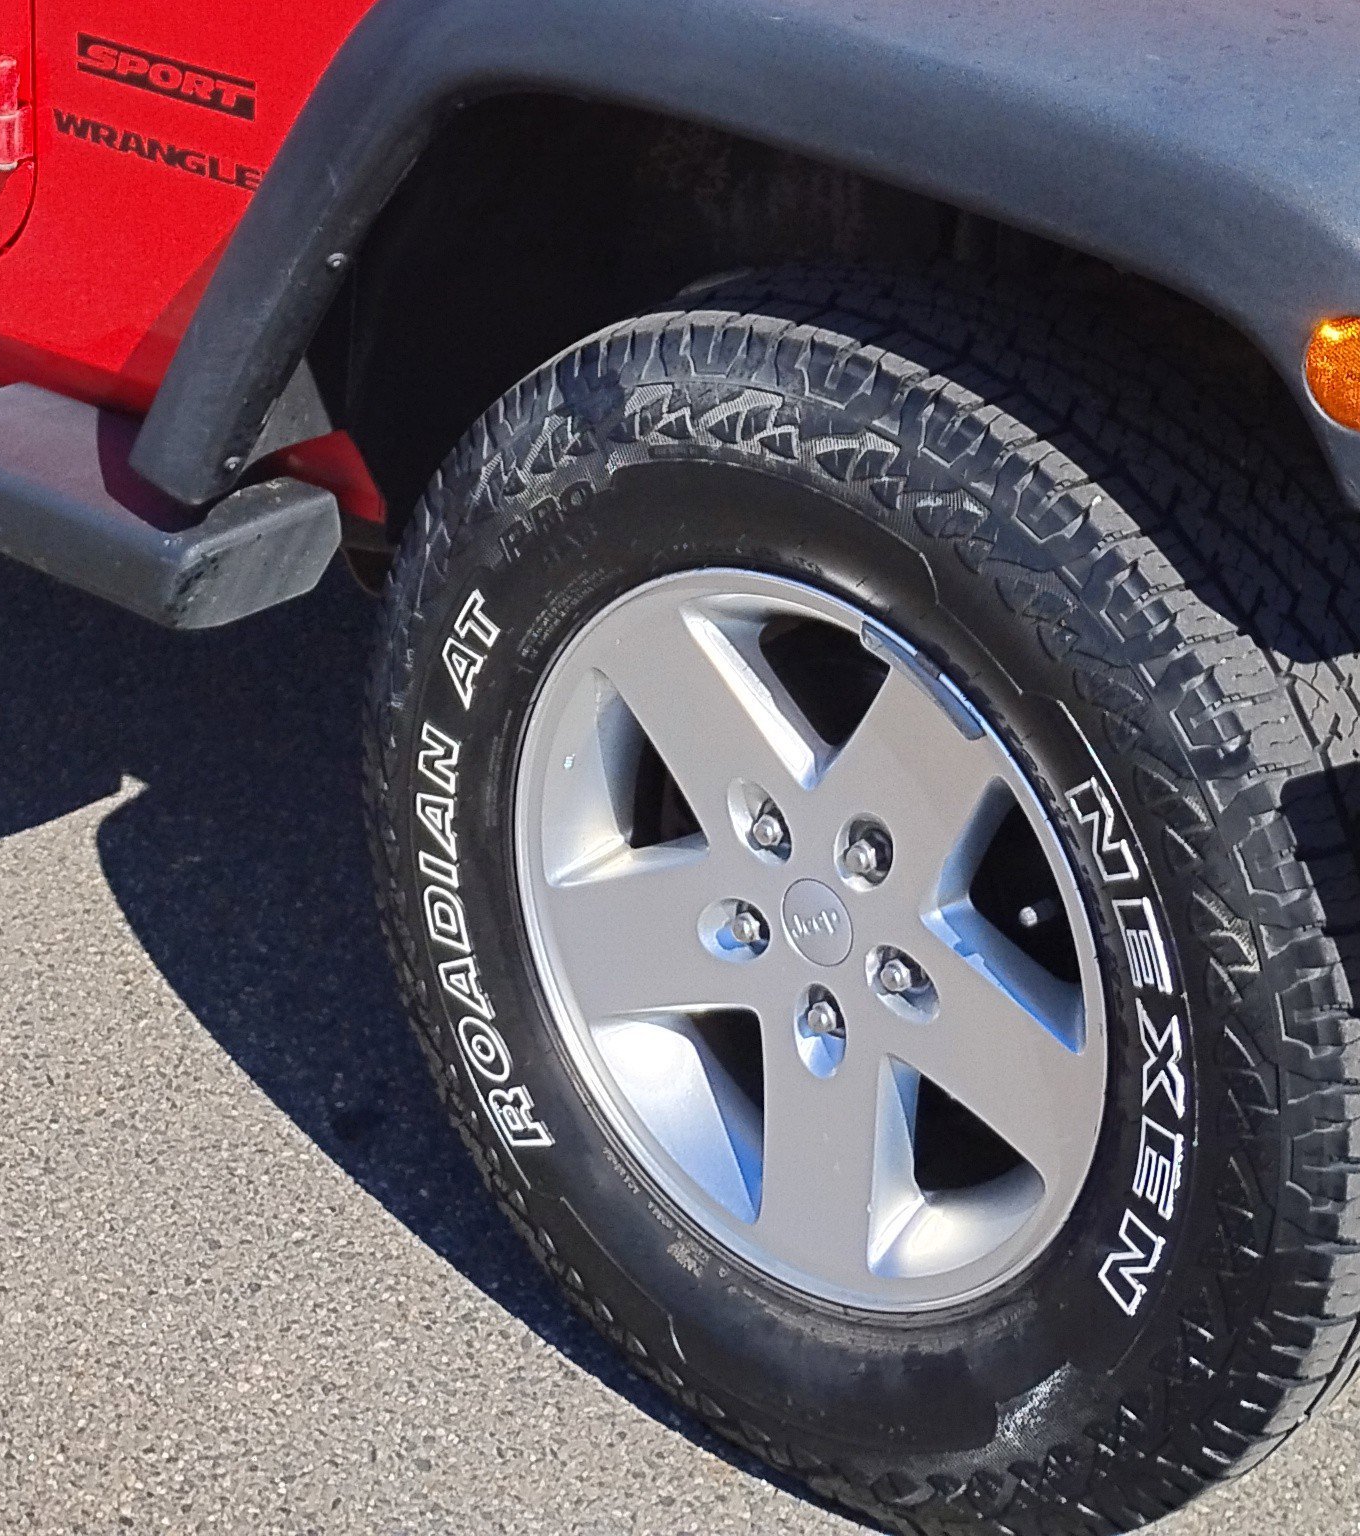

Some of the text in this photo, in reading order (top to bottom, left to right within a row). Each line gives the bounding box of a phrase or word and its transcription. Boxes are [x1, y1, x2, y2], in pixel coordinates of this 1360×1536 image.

[78, 39, 255, 114] SPORT
[52, 107, 263, 193] WRANGLE
[442, 588, 501, 711] AT
[417, 721, 555, 1148] ROADIAN
[790, 908, 840, 941] Jeep
[1065, 776, 1186, 1317] NEXEN
